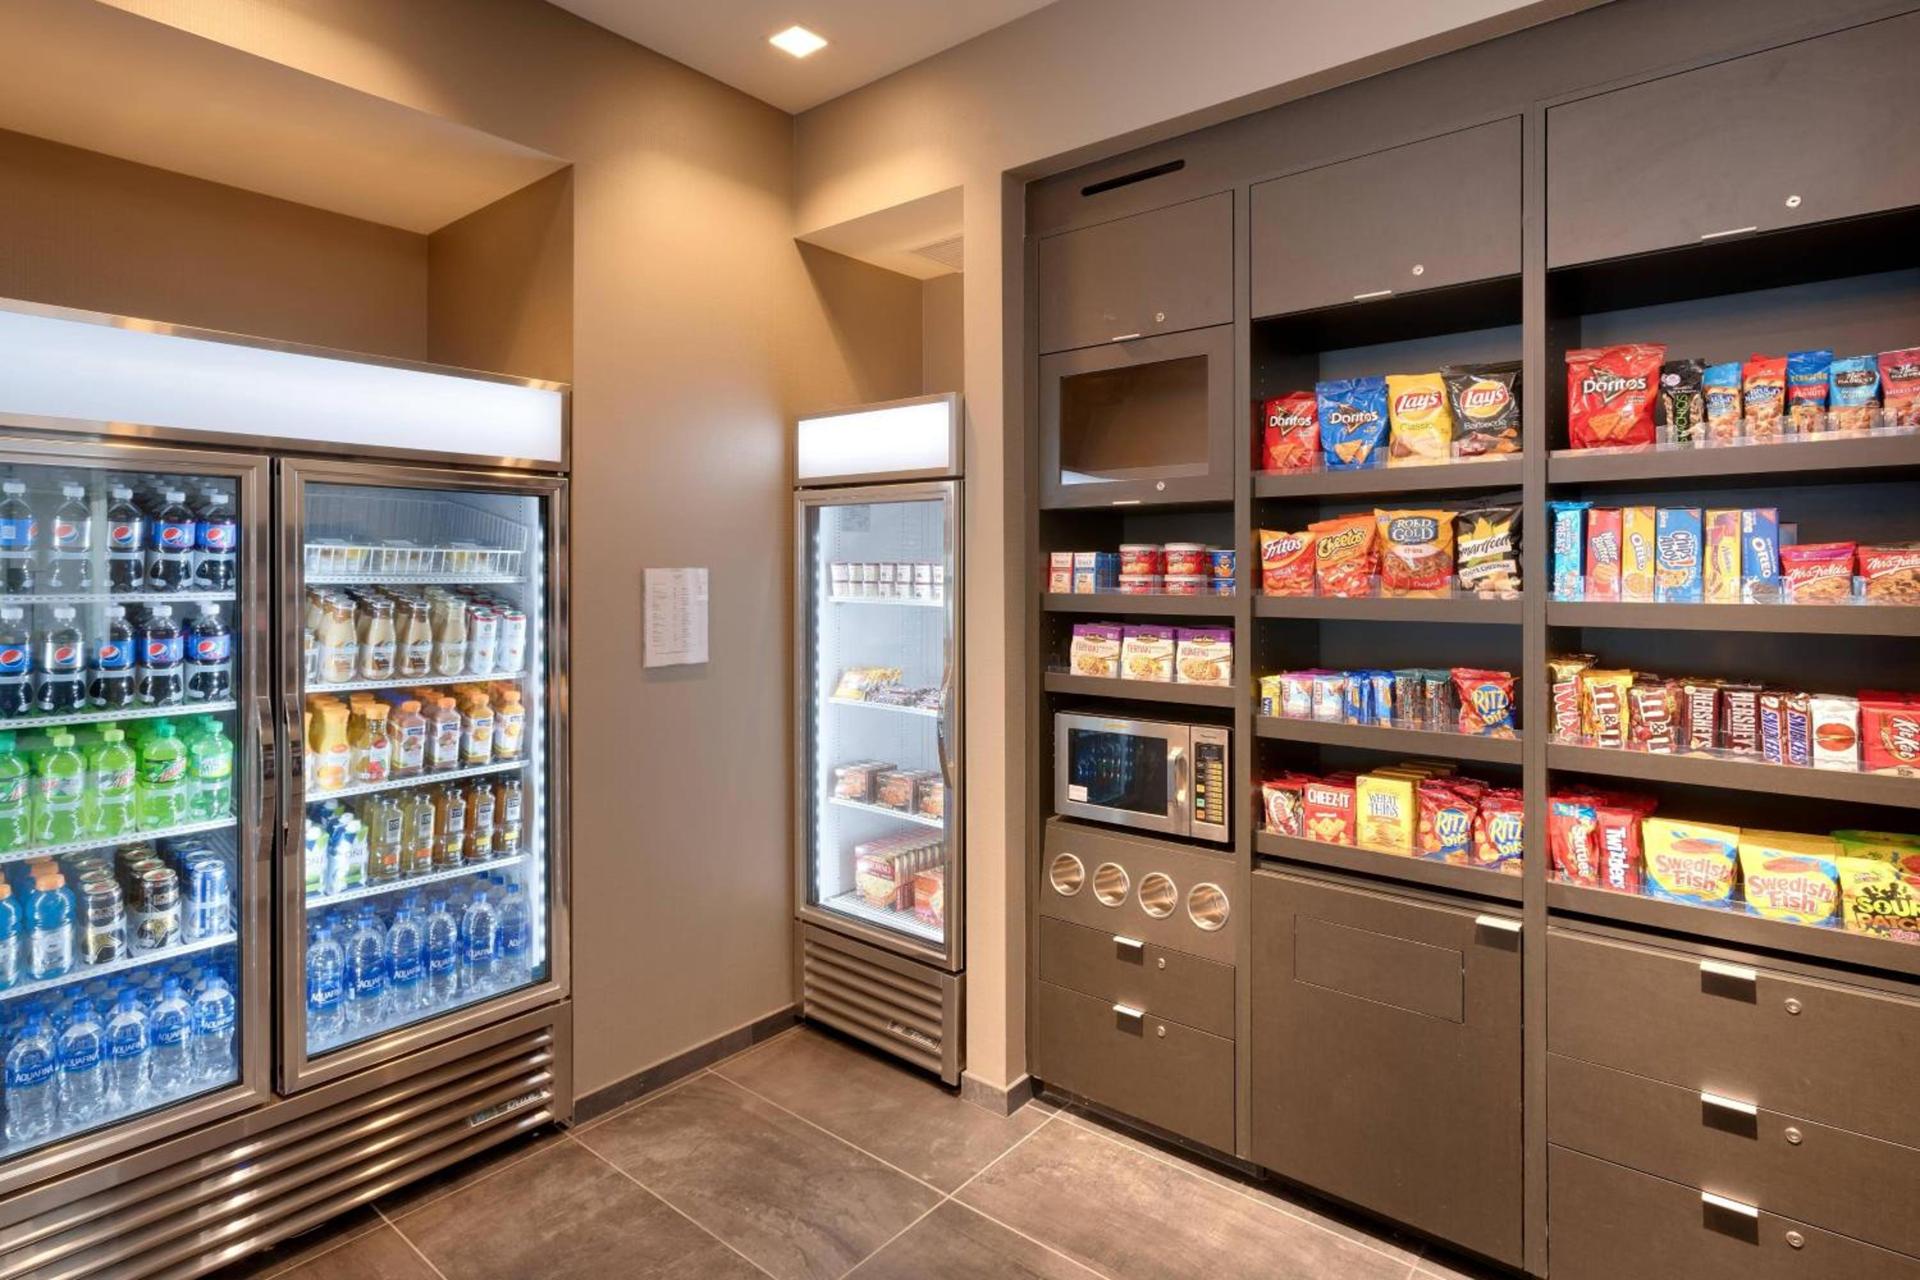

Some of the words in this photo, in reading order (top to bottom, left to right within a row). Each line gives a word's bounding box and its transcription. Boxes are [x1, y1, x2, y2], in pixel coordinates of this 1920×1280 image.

[1582, 378, 1647, 394] Doritos
[1269, 414, 1312, 428] Doritos
[1331, 410, 1379, 425] Doritos
[1317, 529, 1367, 558] Cheetos
[1391, 526, 1434, 541] GOLD
[1262, 539, 1303, 560] Fritos
[1630, 533, 1645, 570] OREO
[1752, 537, 1772, 579] OREO
[1472, 689, 1508, 715] RITZ
[1553, 675, 1581, 740] TWIX
[1762, 708, 1781, 763] SNICKERS
[1308, 788, 1350, 808] CHEEZ-IT
[1436, 811, 1468, 836] RITZ
[1655, 854, 1736, 882] Swedish
[1674, 870, 1717, 891] Fish
[1748, 875, 1835, 903] Swedish
[1768, 890, 1816, 913] Fish
[1857, 913, 1920, 931] PATC
